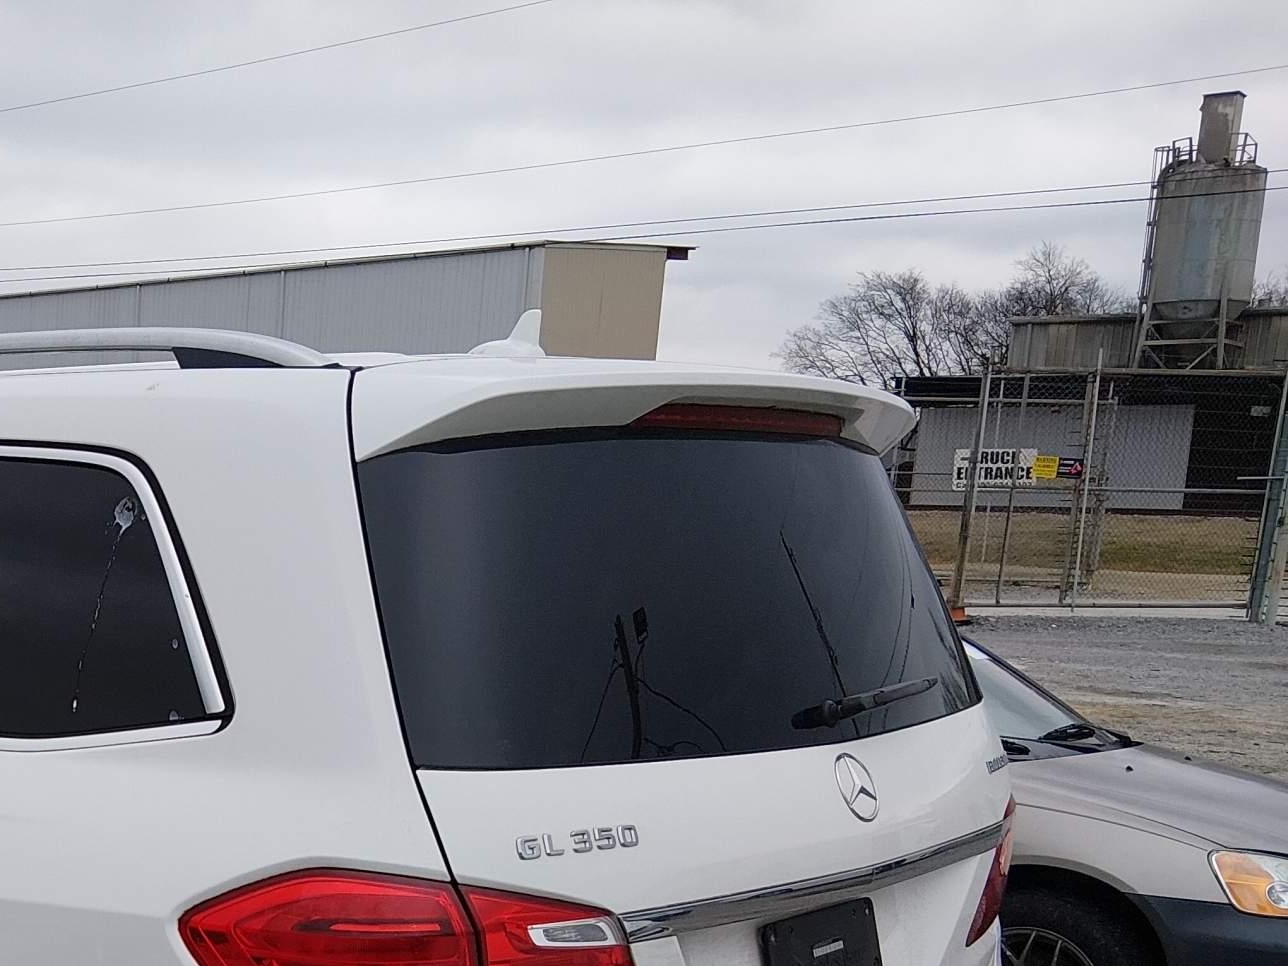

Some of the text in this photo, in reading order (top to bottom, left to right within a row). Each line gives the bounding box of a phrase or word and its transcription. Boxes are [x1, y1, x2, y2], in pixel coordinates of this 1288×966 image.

[973, 450, 1022, 465] RUC
[515, 824, 640, 861] GL 350
